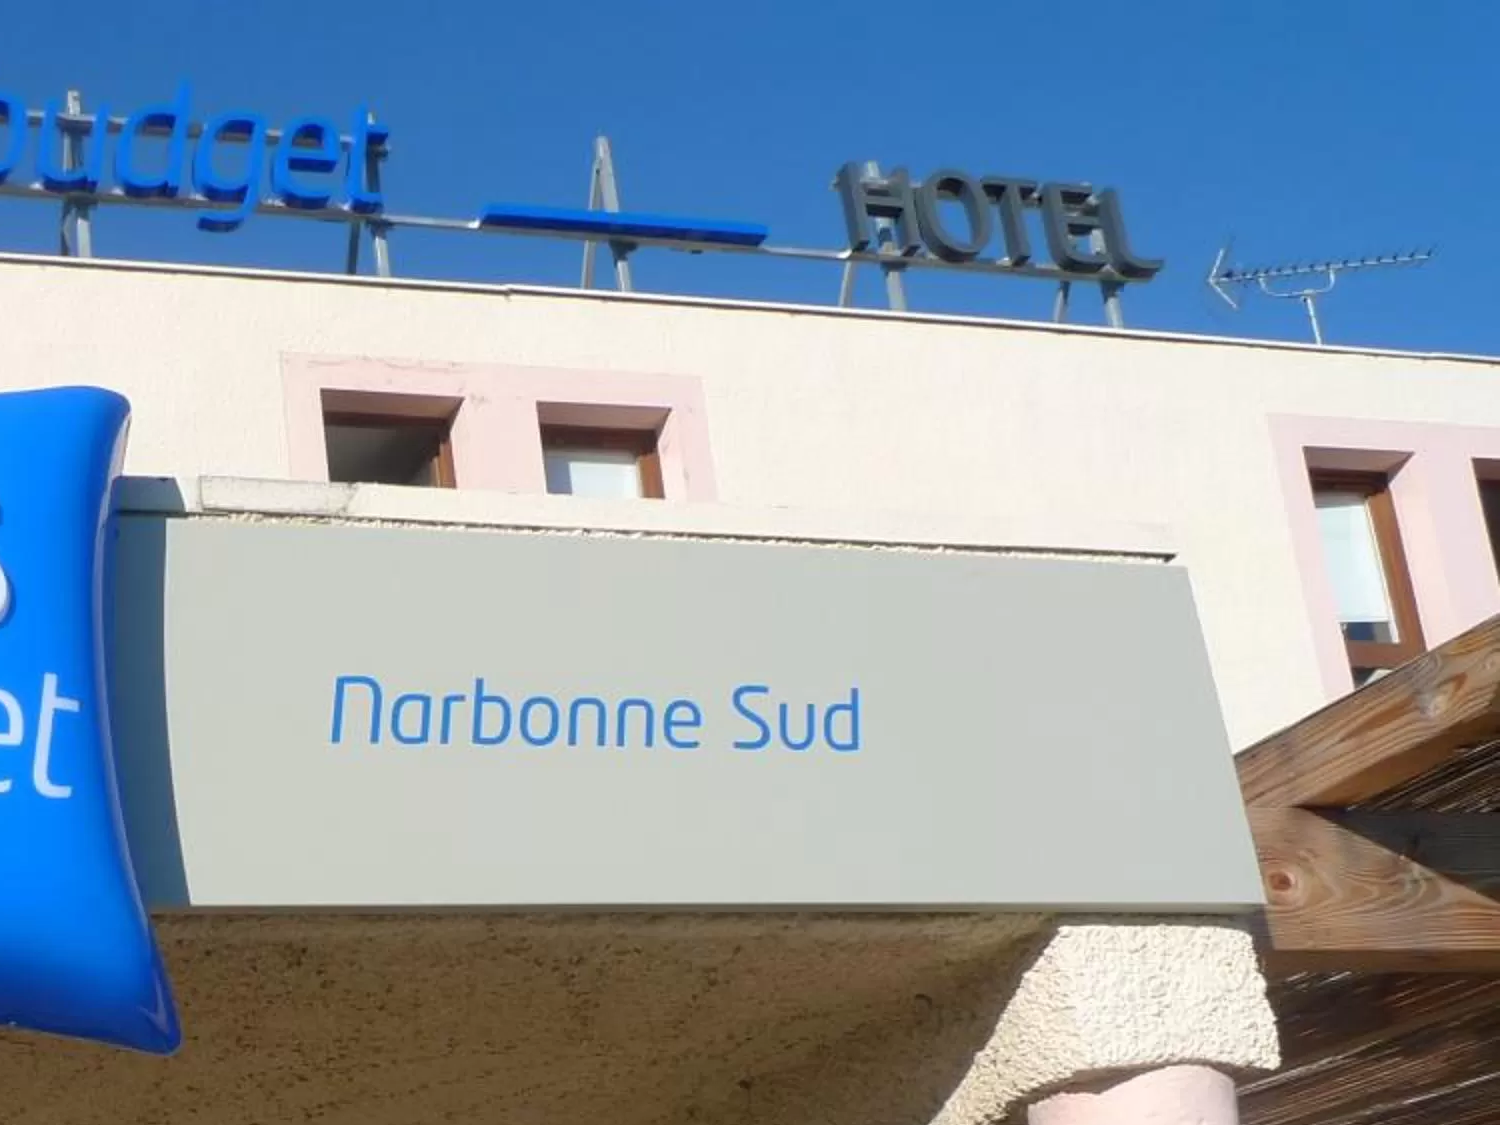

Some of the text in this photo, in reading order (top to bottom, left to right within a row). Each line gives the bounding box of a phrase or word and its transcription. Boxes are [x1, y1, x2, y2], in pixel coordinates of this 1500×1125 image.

[834, 160, 1164, 280] HOTEL
[330, 675, 860, 752] Narbonne Sud
